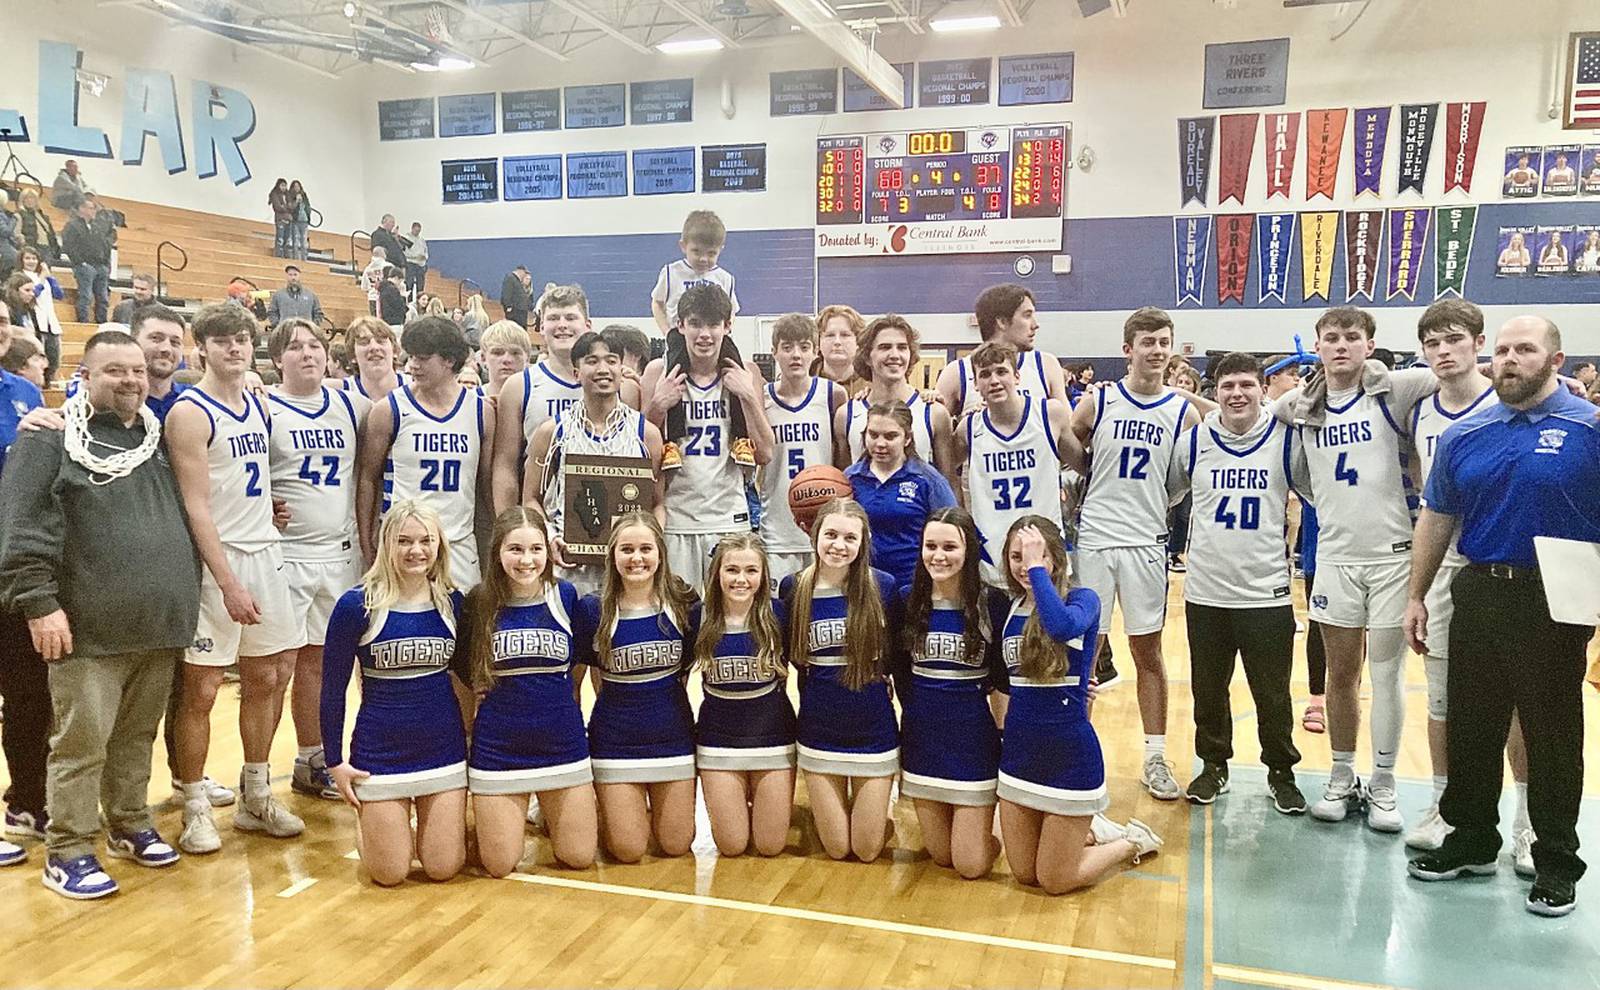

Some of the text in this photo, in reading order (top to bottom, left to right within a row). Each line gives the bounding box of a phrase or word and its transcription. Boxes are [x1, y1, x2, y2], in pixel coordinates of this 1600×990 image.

[1012, 62, 1059, 73] VOLLEYBALL
[1229, 53, 1266, 65] THREE
[1039, 73, 1071, 82] CHAMPS
[1225, 67, 1267, 79] RIVERS
[958, 81, 986, 91] CHAMPS
[1022, 141, 1031, 151] 4
[1034, 140, 1042, 151] 0
[1274, 115, 1288, 187] HALL
[1317, 112, 1330, 188] KEWANEE
[1363, 114, 1377, 177] MENDOTA
[1403, 111, 1418, 177] MONMOUTH
[1412, 106, 1428, 181] ROSEVILLE
[1454, 102, 1471, 183] MORRISON
[837, 150, 844, 161] 0
[874, 158, 903, 169] STORM
[971, 153, 1000, 164] GUEST
[1186, 121, 1196, 187] BUREAU
[1195, 128, 1205, 193] VALLEY
[836, 162, 844, 174] 0
[854, 161, 861, 173] 0
[931, 170, 942, 185] 4
[977, 165, 1000, 186] 37
[1014, 165, 1060, 179] 22 3 6
[819, 175, 834, 187] 20
[854, 174, 861, 185] 0
[879, 170, 902, 190] 68
[1014, 180, 1030, 192] 24
[1052, 178, 1060, 190] 0
[819, 187, 834, 199] 30
[854, 187, 861, 198] 2
[898, 197, 909, 213] 3
[963, 194, 975, 210] 4
[990, 194, 1000, 210] 8
[1014, 193, 1030, 206] 34
[819, 199, 861, 212] 32 0 0
[925, 213, 945, 221] MATCH
[818, 232, 879, 248] Donated by:
[909, 224, 988, 239] Central Bank
[1185, 219, 1197, 291] NEWMAN
[1226, 220, 1239, 290] ORION
[1267, 215, 1281, 290] PRINCETON
[1313, 215, 1323, 290] RIVERDALE
[1356, 212, 1370, 291] ROCKRIDGE
[1397, 209, 1416, 290] SHERRARD
[1446, 240, 1459, 280] BEDE
[682, 400, 727, 420] TIGERS
[289, 429, 345, 450] TIGERS
[685, 425, 721, 456] 23
[772, 422, 820, 444] TIGERS
[1113, 419, 1164, 446] TIGERS
[1314, 420, 1373, 449] TIGERS
[412, 433, 469, 454] TIGERS
[299, 455, 341, 487] 42
[575, 465, 643, 477] REGIONAL
[788, 449, 805, 479] 5
[983, 448, 1036, 473] TIGERS
[1118, 446, 1151, 480] 12
[1334, 452, 1359, 486] 4
[245, 461, 262, 497] 2
[420, 459, 461, 492] 20
[1210, 468, 1269, 490] TIGERS
[793, 487, 836, 501] Wilson
[992, 475, 1032, 510] 32
[617, 503, 642, 513] 2023
[1215, 496, 1260, 530] 40
[569, 545, 606, 553] CHAM
[370, 636, 456, 668] TIGERS
